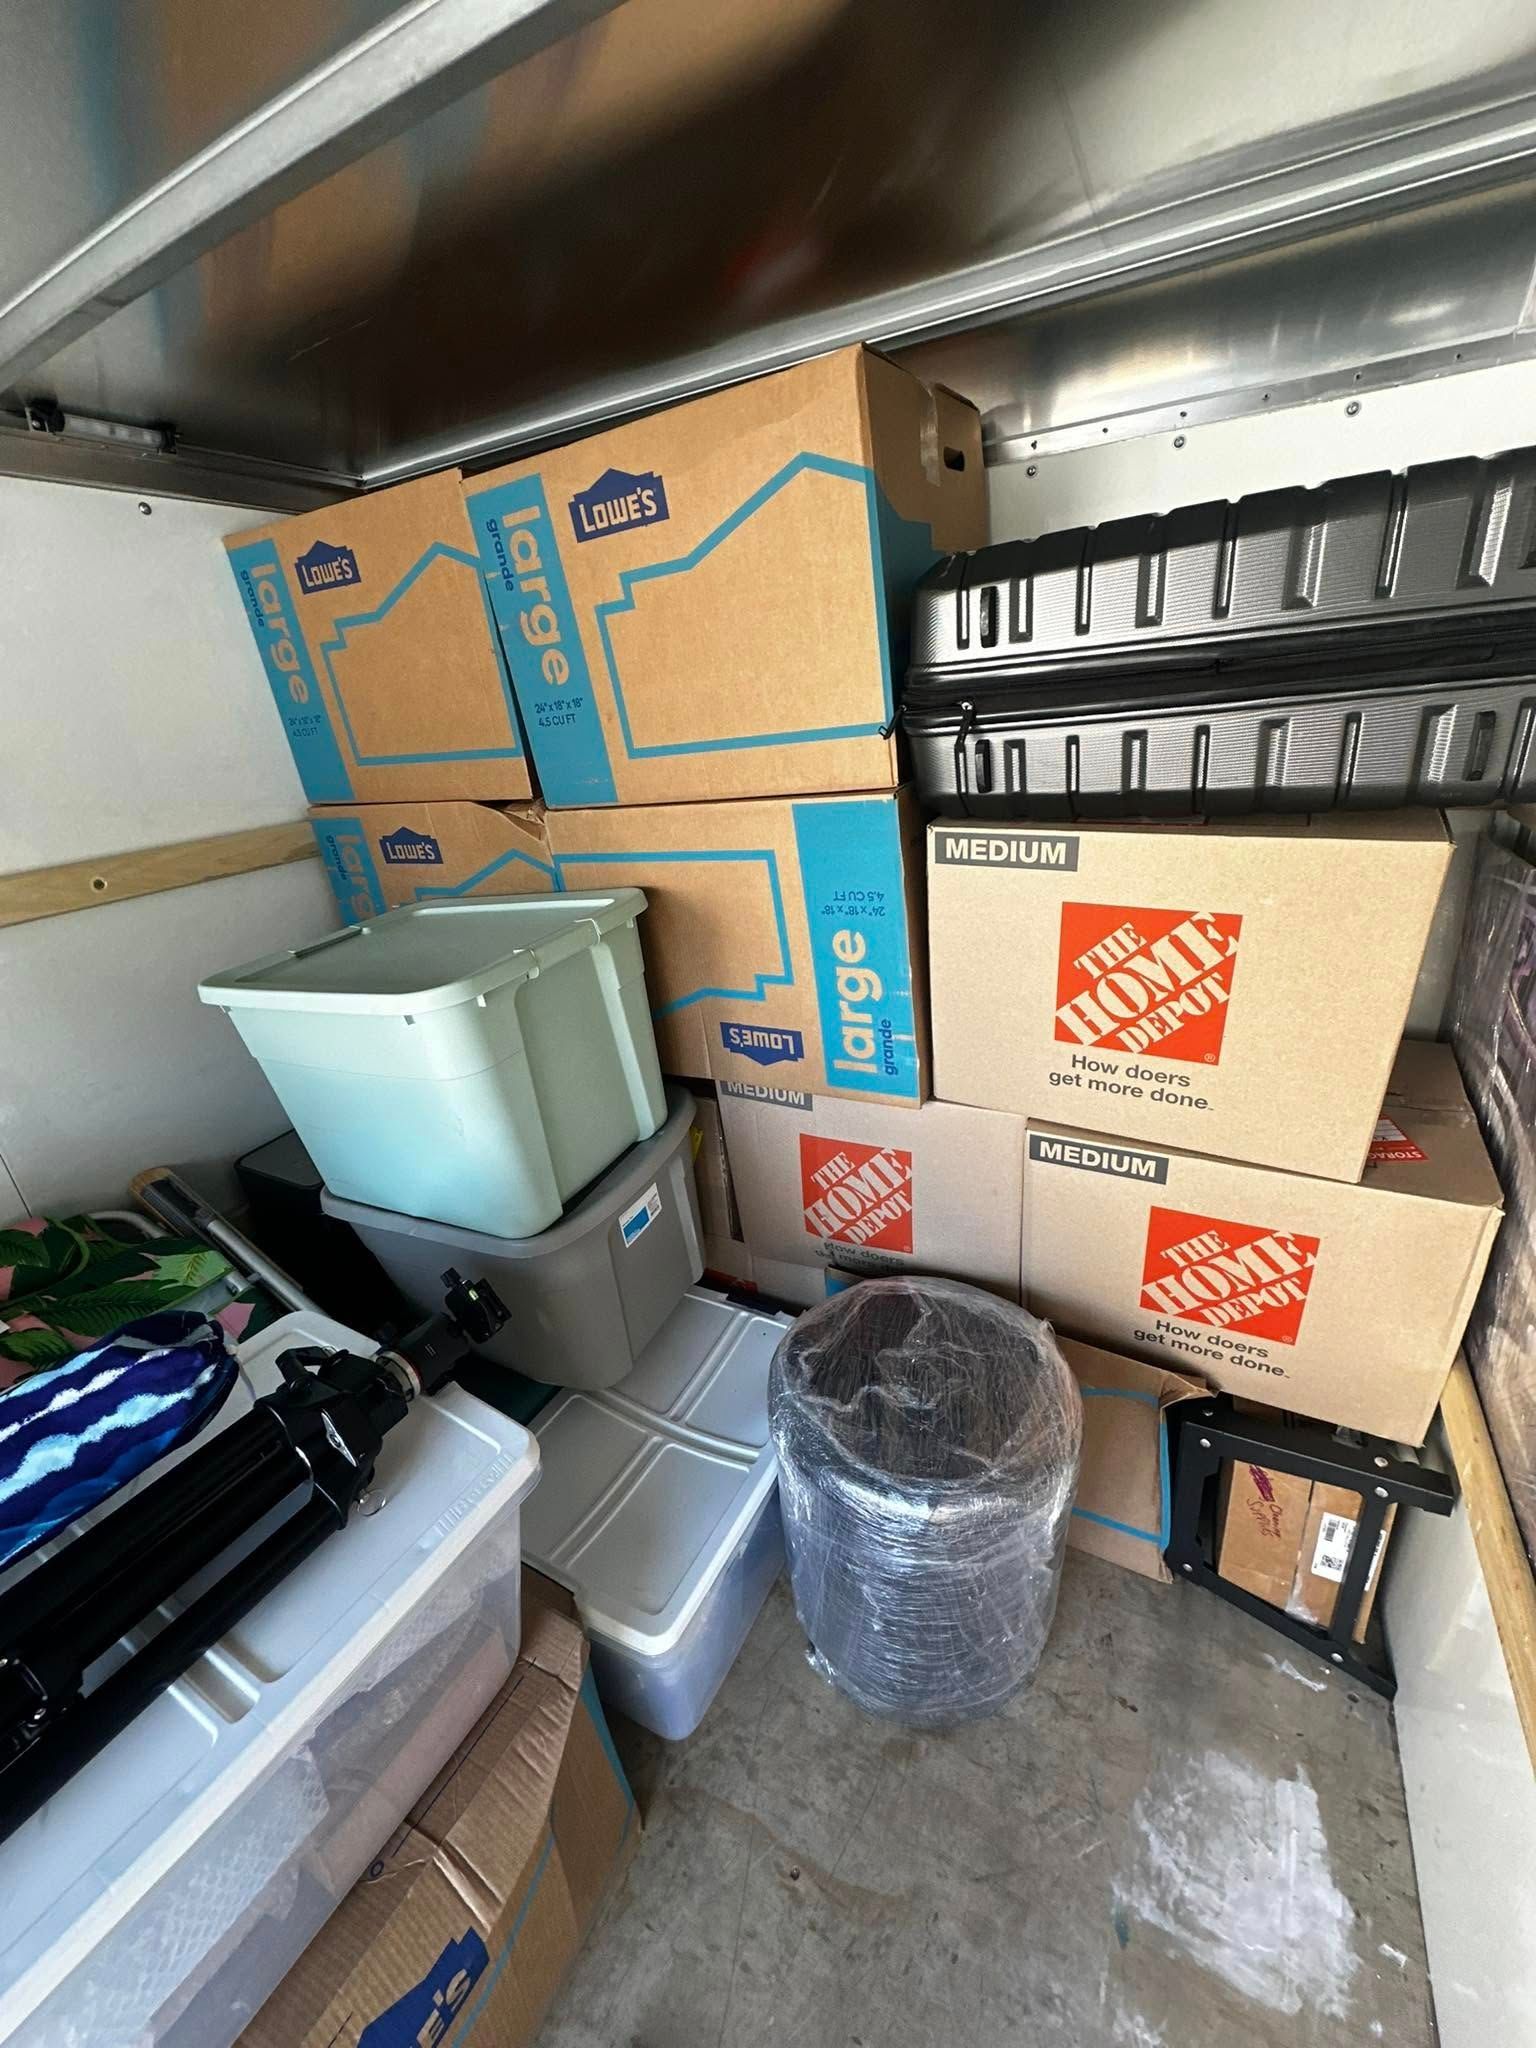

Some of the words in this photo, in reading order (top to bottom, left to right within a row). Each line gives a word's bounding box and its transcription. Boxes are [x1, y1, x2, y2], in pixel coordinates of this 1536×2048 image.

[579, 487, 658, 534] LOWE'S
[302, 557, 353, 588] LOWE'S
[486, 518, 514, 592] grande
[240, 569, 264, 628] grande
[502, 505, 570, 686] large
[250, 563, 309, 705] large
[552, 715, 565, 726] CU
[566, 713, 576, 724] FT
[326, 834, 348, 881] grande
[386, 841, 435, 860] LOWE'S
[946, 838, 1066, 865] MEDIUM
[338, 835, 374, 916] larg
[833, 891, 846, 901] FT
[848, 891, 866, 902] CU
[1073, 922, 1147, 980] THE
[833, 929, 883, 1074] large
[1056, 911, 1239, 1046] HOME
[1116, 972, 1230, 1054] DEPOT
[730, 1028, 794, 1055] LOWE'S
[882, 1018, 897, 1076] grande
[727, 1081, 805, 1106] MEDIUM
[1049, 1070, 1082, 1088] get
[1088, 1079, 1143, 1098] more
[1150, 1086, 1213, 1110] done.
[1072, 1054, 1118, 1076] How
[1126, 1064, 1191, 1087] doers
[810, 1152, 856, 1191] THE
[1039, 1141, 1156, 1178] MEDIUM
[803, 1146, 912, 1240] HOME
[844, 1190, 912, 1245] DEPOT
[1161, 1230, 1230, 1268] THE
[1142, 1231, 1317, 1315] HOME
[1200, 1277, 1307, 1328] DEPOT
[1134, 1330, 1166, 1346] get
[1171, 1339, 1223, 1361] more
[1230, 1352, 1290, 1378] done.
[1156, 1319, 1200, 1340] How
[1207, 1335, 1270, 1359] doers
